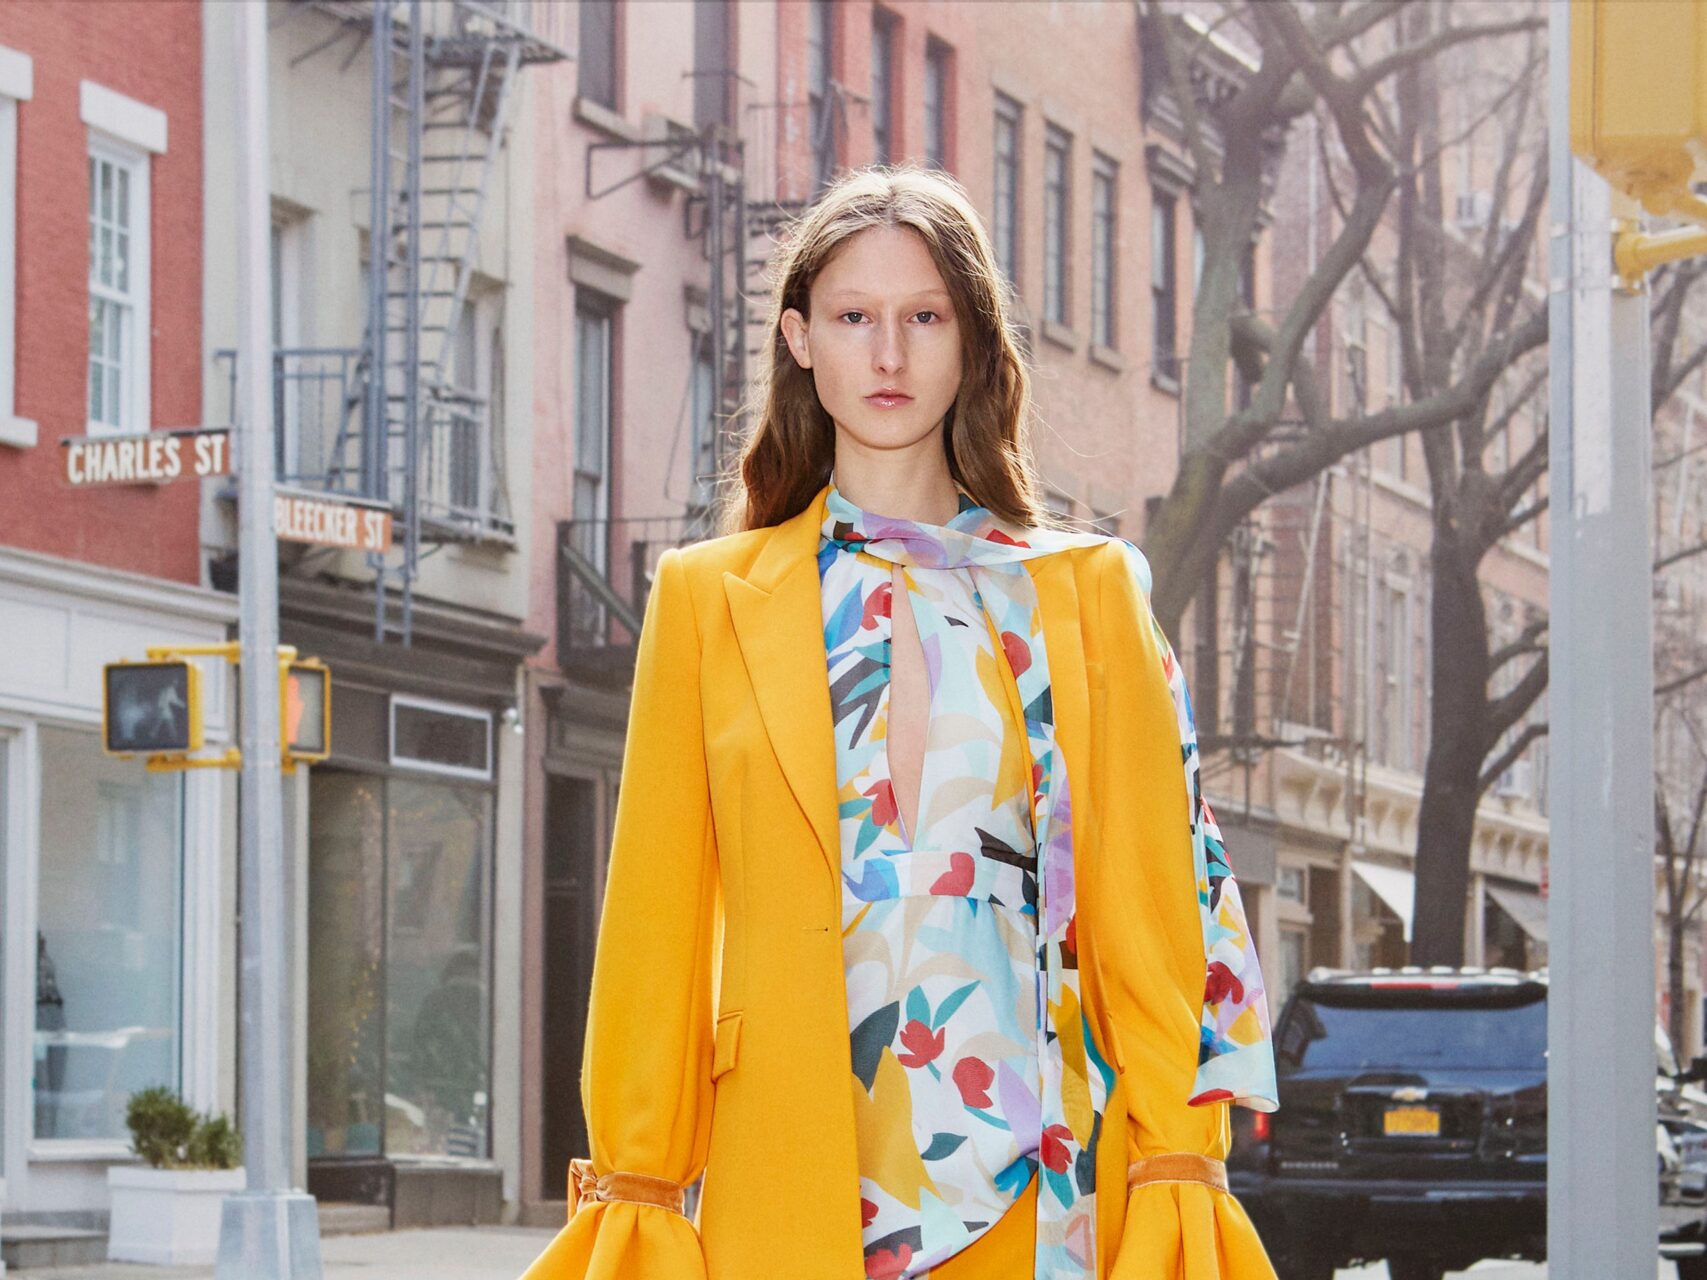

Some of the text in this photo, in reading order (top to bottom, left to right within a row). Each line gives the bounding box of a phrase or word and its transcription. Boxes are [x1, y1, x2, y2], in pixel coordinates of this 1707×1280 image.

[67, 434, 226, 484] CHARLES ST
[275, 497, 385, 549] BLEECKER ST
